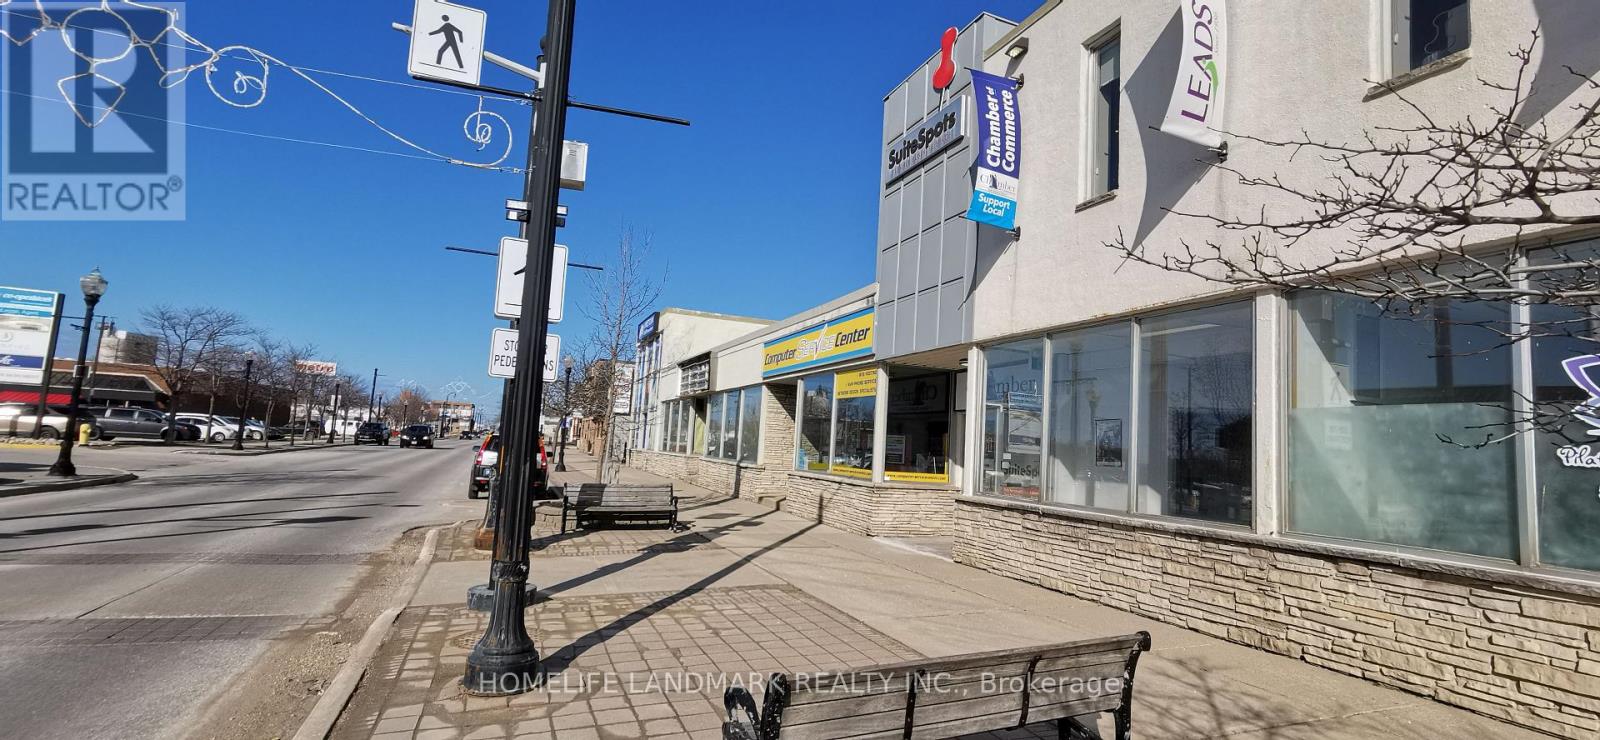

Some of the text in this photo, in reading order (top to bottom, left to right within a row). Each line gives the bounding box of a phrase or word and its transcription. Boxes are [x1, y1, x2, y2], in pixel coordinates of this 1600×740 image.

[1181, 0, 1213, 123] LEADS
[888, 111, 957, 170] SuiteSpots
[985, 95, 1001, 168] Chamber
[1001, 89, 1016, 172] Commerce
[978, 193, 1010, 209] Support
[982, 203, 1005, 217] Local
[764, 347, 798, 366] Computer
[834, 326, 871, 348] Center
[1559, 446, 1600, 466] Pila
